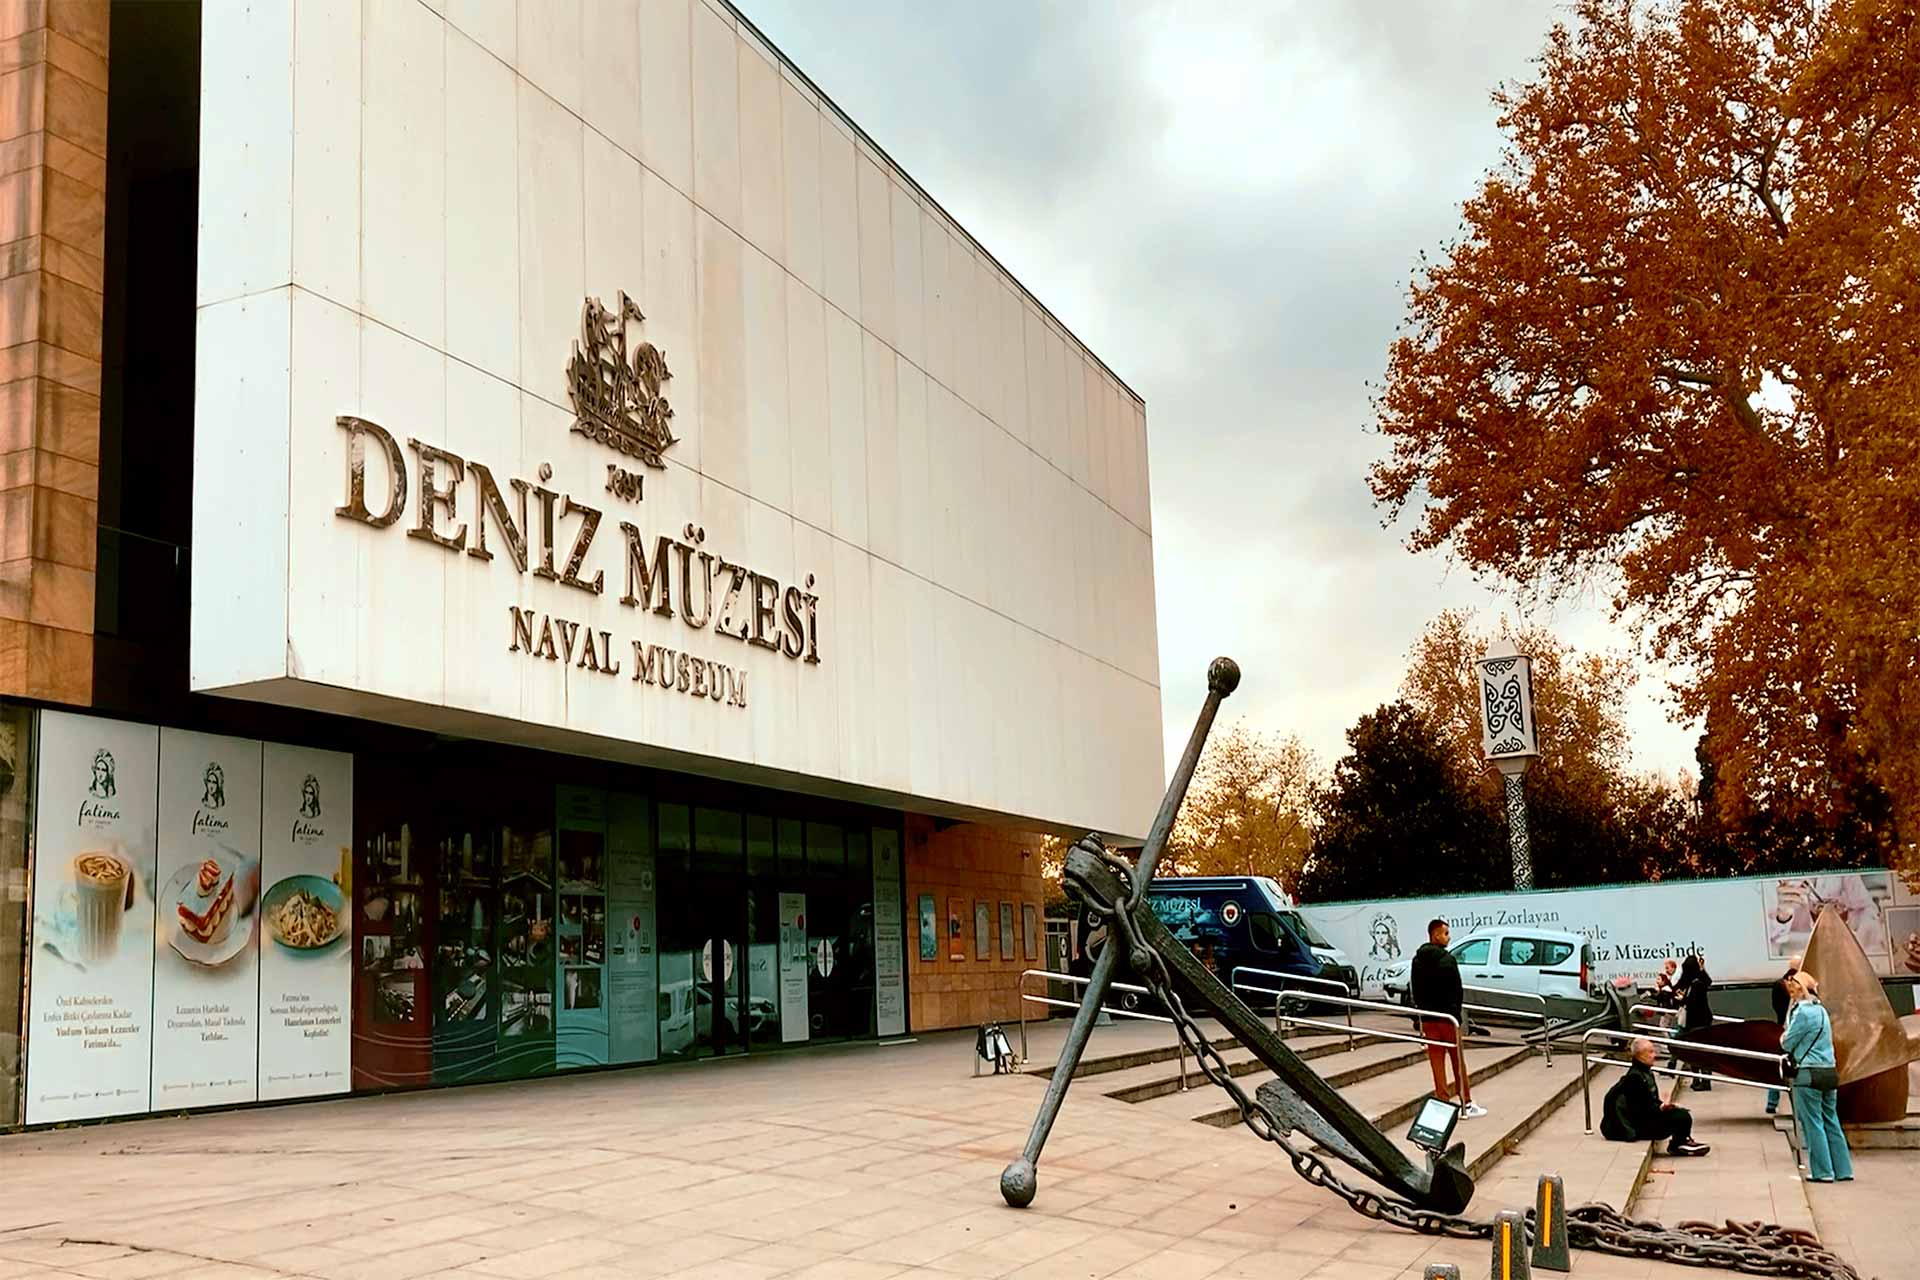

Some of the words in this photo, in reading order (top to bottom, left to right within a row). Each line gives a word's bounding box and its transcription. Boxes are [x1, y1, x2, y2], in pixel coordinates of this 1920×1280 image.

[335, 414, 603, 597] DENİZ
[618, 520, 821, 665] MÜZESİ
[508, 605, 620, 676] NAVAL
[631, 639, 749, 708] MUSEUM
[78, 800, 121, 827] fatima
[191, 809, 229, 835] fatima
[291, 819, 325, 843] fatima
[1496, 908, 1560, 928] Zorlayan
[1615, 941, 1705, 962] Müzesi'nde
